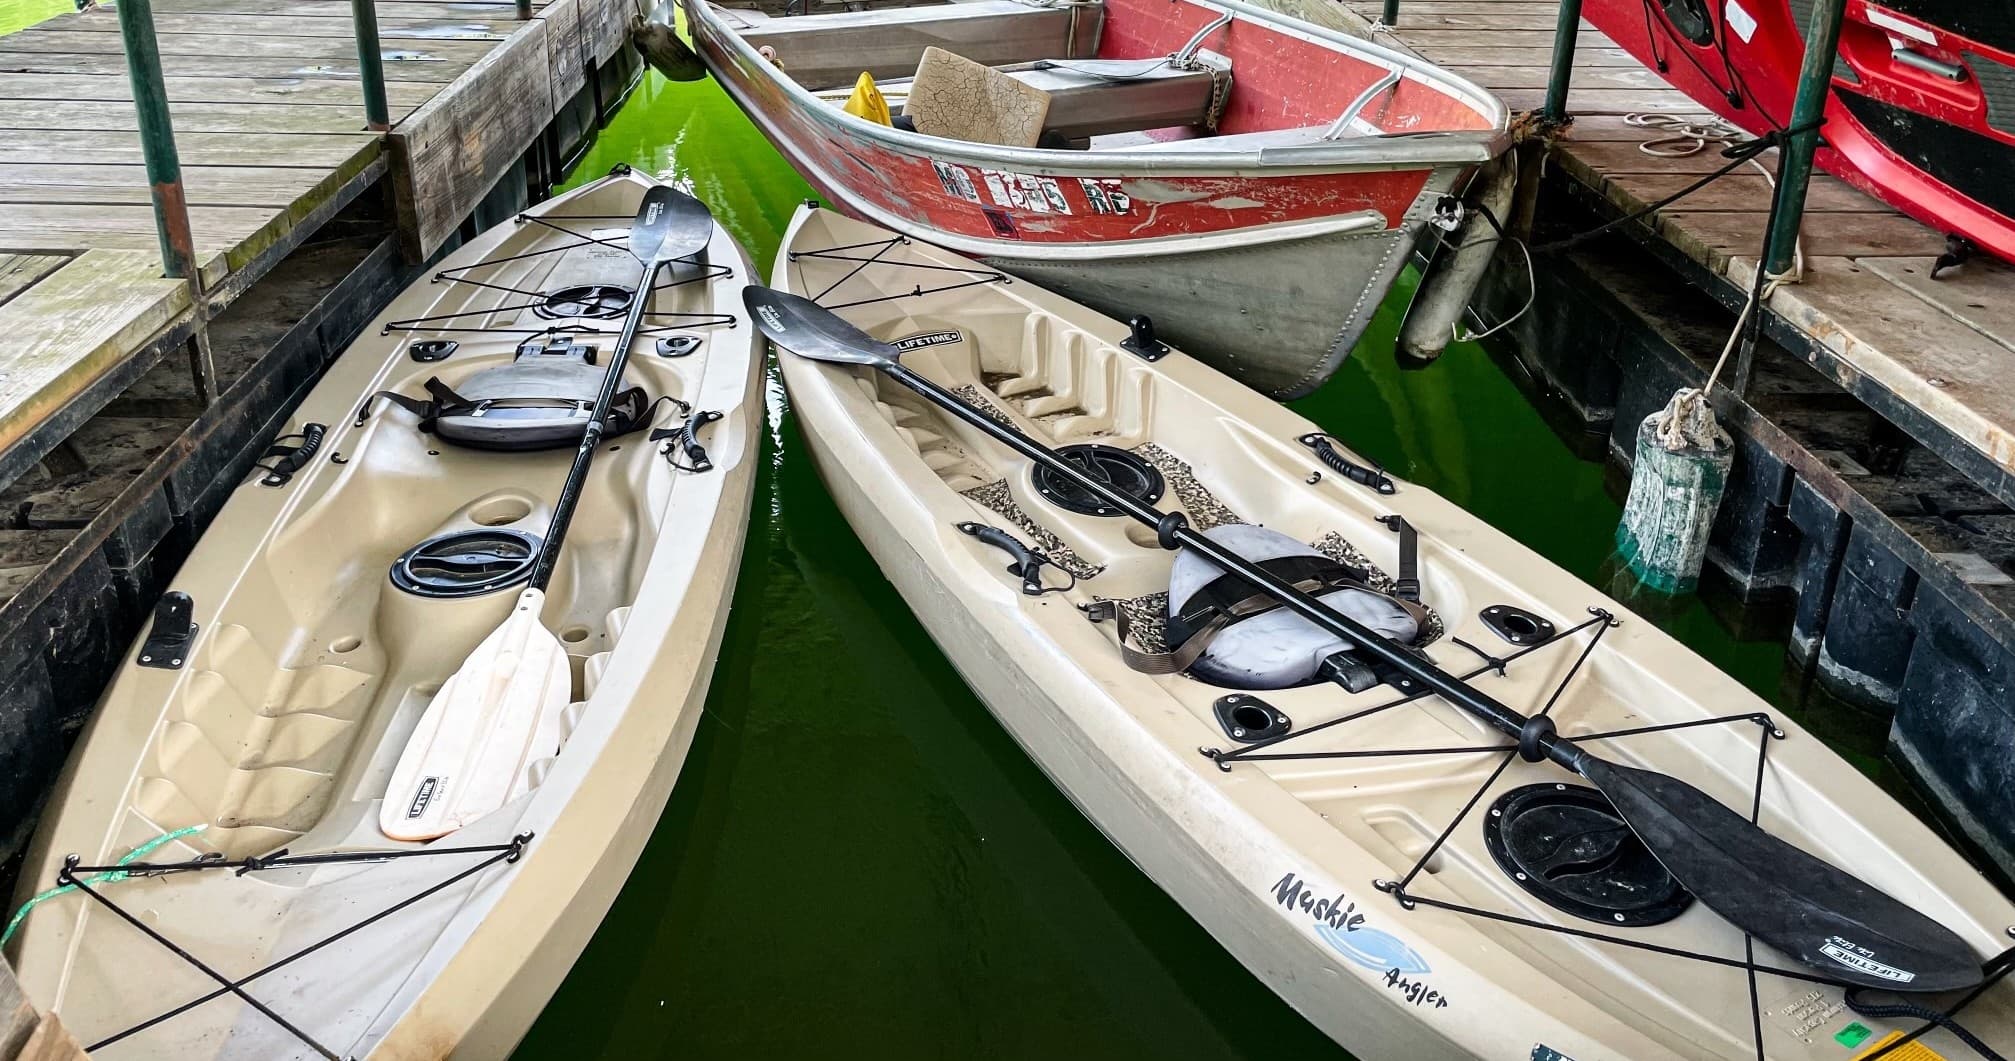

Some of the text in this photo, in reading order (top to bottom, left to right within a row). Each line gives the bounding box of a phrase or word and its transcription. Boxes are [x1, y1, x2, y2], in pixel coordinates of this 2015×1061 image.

[897, 333, 953, 350] LIFETIME
[410, 780, 435, 816] LIFETIME
[1271, 872, 1365, 932] Muskie
[1832, 949, 1902, 979] LIFETIME
[1382, 967, 1448, 1009] Angler
